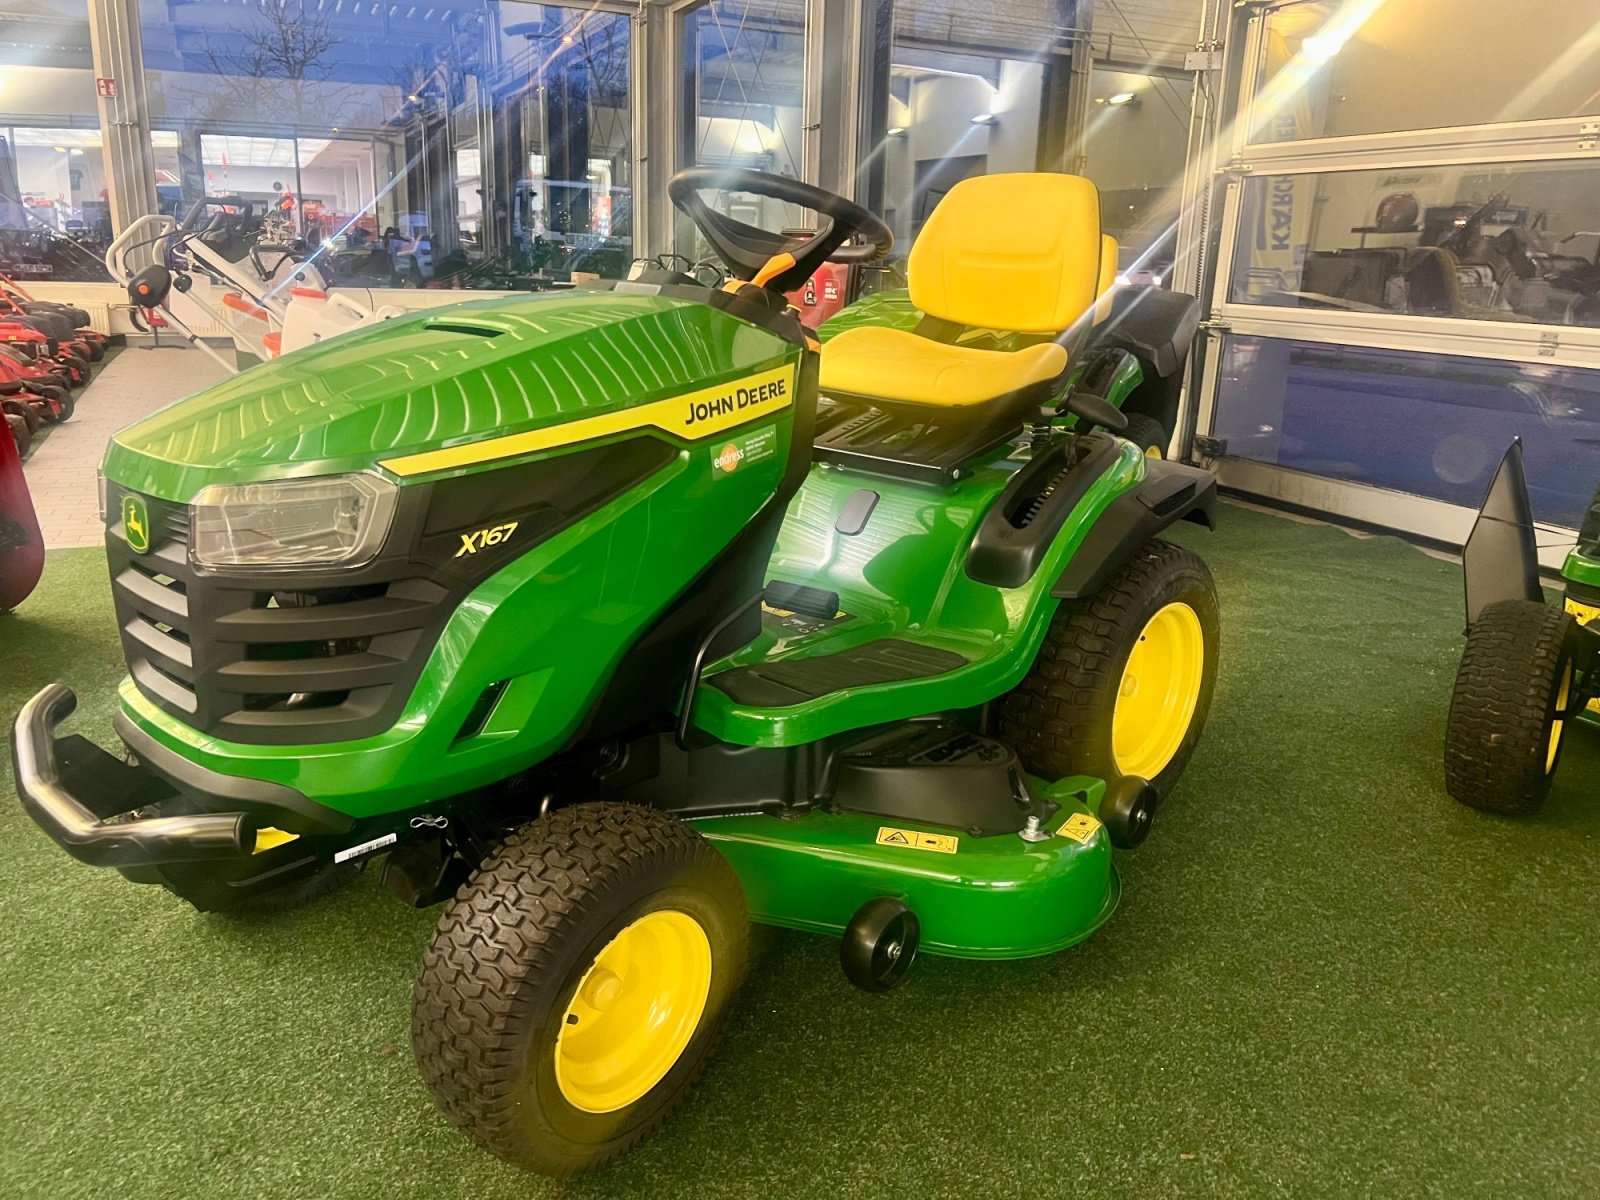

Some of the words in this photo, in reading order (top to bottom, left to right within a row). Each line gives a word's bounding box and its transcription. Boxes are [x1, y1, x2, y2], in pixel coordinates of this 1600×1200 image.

[685, 395, 733, 425] JOHN
[736, 378, 786, 409] DEERE
[713, 448, 745, 469] endress
[455, 521, 519, 558] X167
